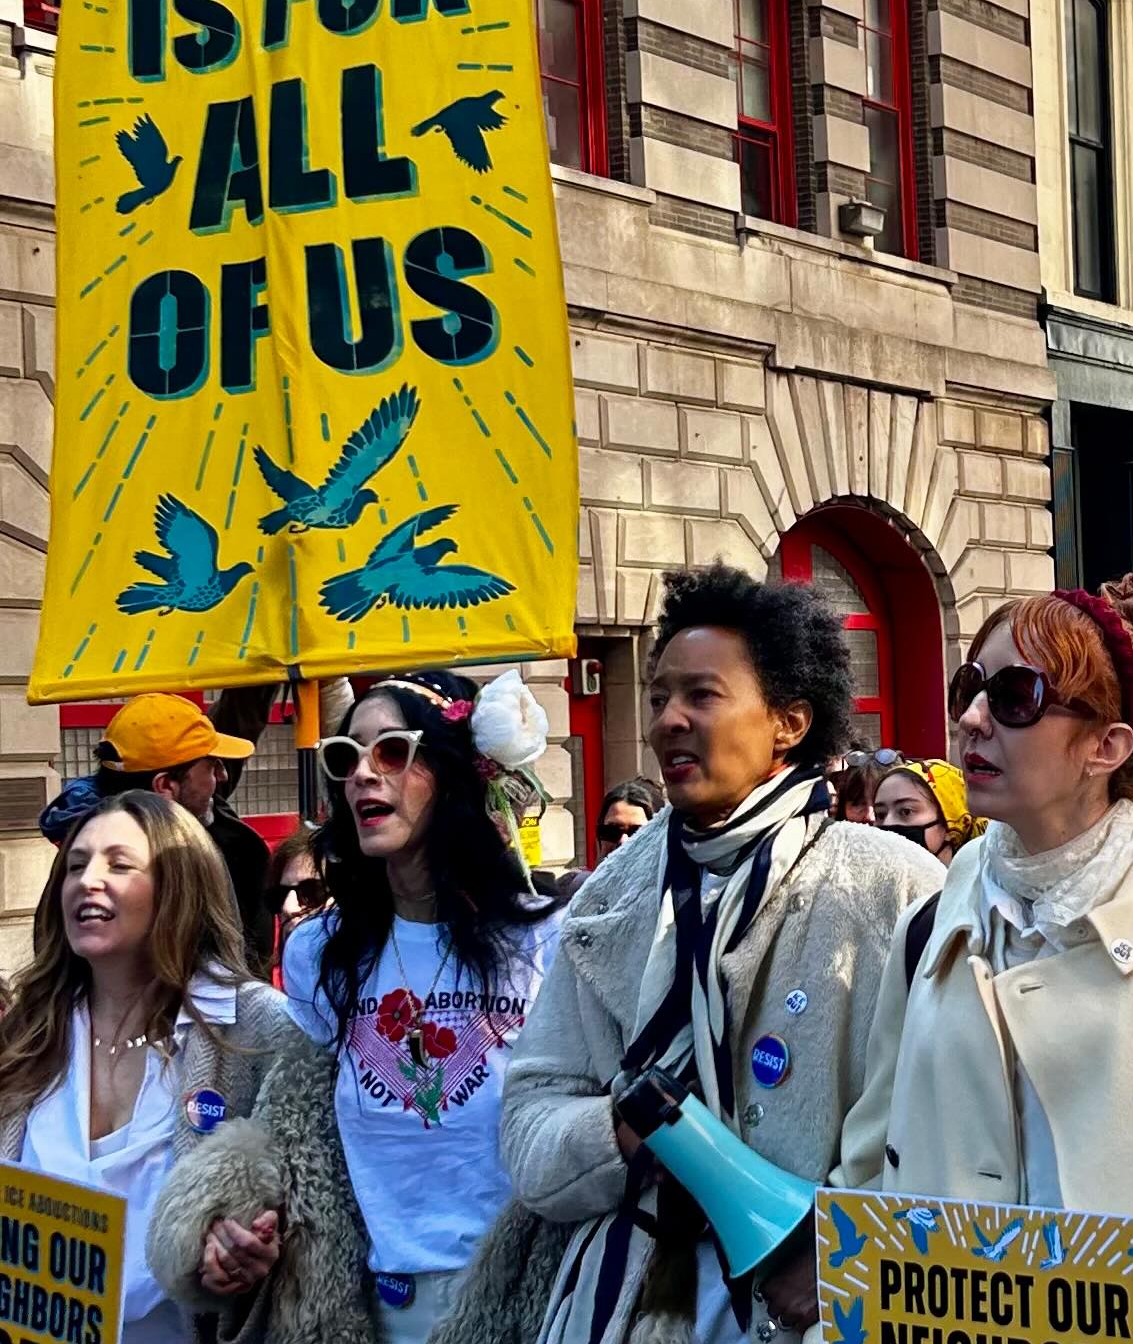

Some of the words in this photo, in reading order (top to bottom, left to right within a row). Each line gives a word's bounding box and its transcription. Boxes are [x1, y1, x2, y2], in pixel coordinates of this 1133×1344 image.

[188, 63, 419, 237] ALL
[127, 255, 272, 402] OF
[304, 225, 502, 376] US
[424, 991, 526, 1015] ABORTION
[359, 1069, 398, 1107] NOT
[449, 1063, 490, 1107] WAR
[752, 1048, 785, 1073] RESIST
[187, 1100, 226, 1117] RESIST
[50, 1230, 107, 1295] OUR
[879, 1258, 1035, 1329] PROTECT
[1047, 1277, 1132, 1340] OUR
